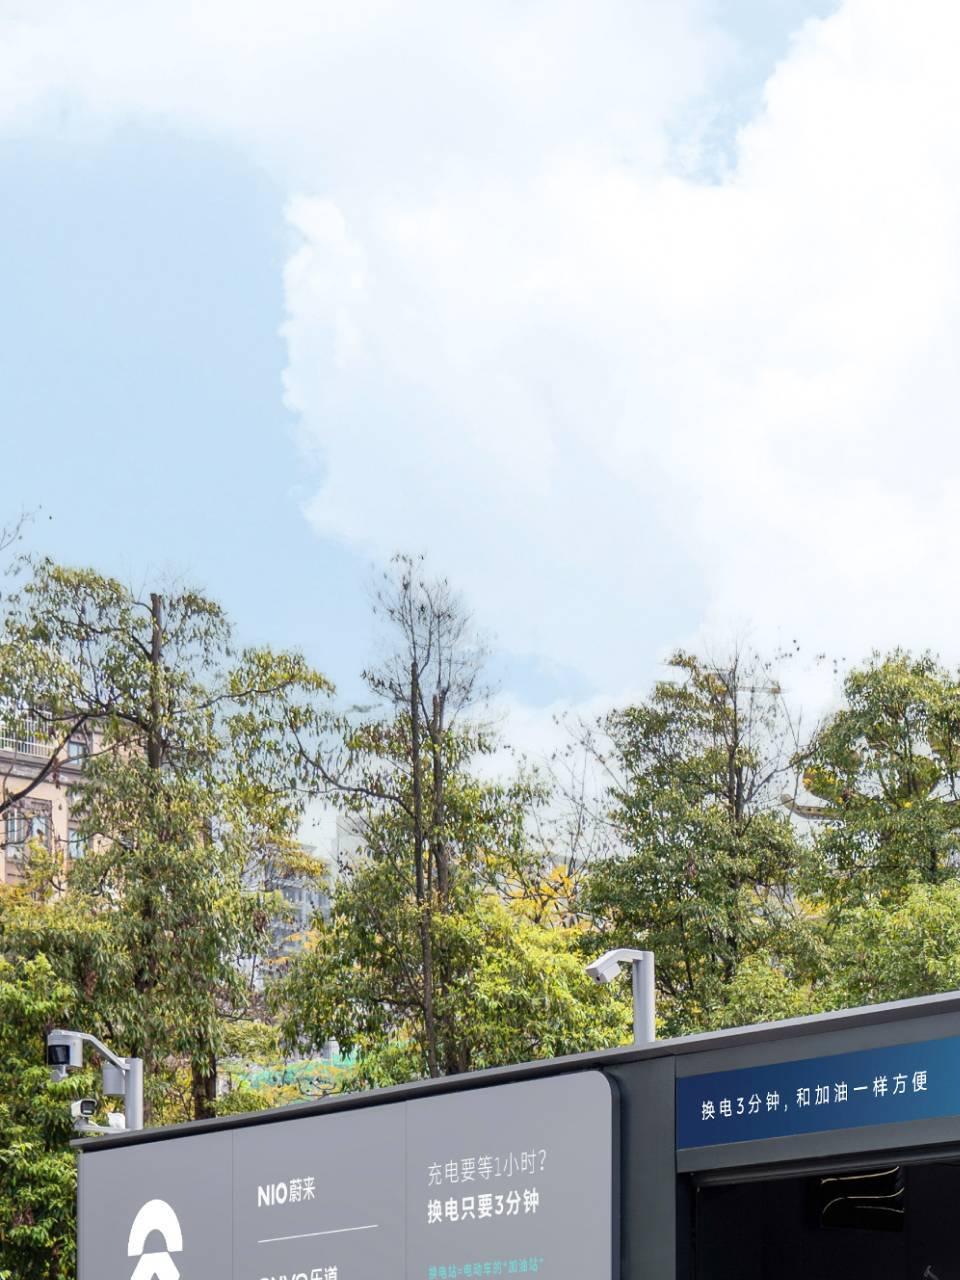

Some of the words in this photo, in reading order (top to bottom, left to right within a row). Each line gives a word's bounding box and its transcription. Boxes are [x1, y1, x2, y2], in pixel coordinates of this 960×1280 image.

[427, 1187, 540, 1224] 换电只要3分钟
